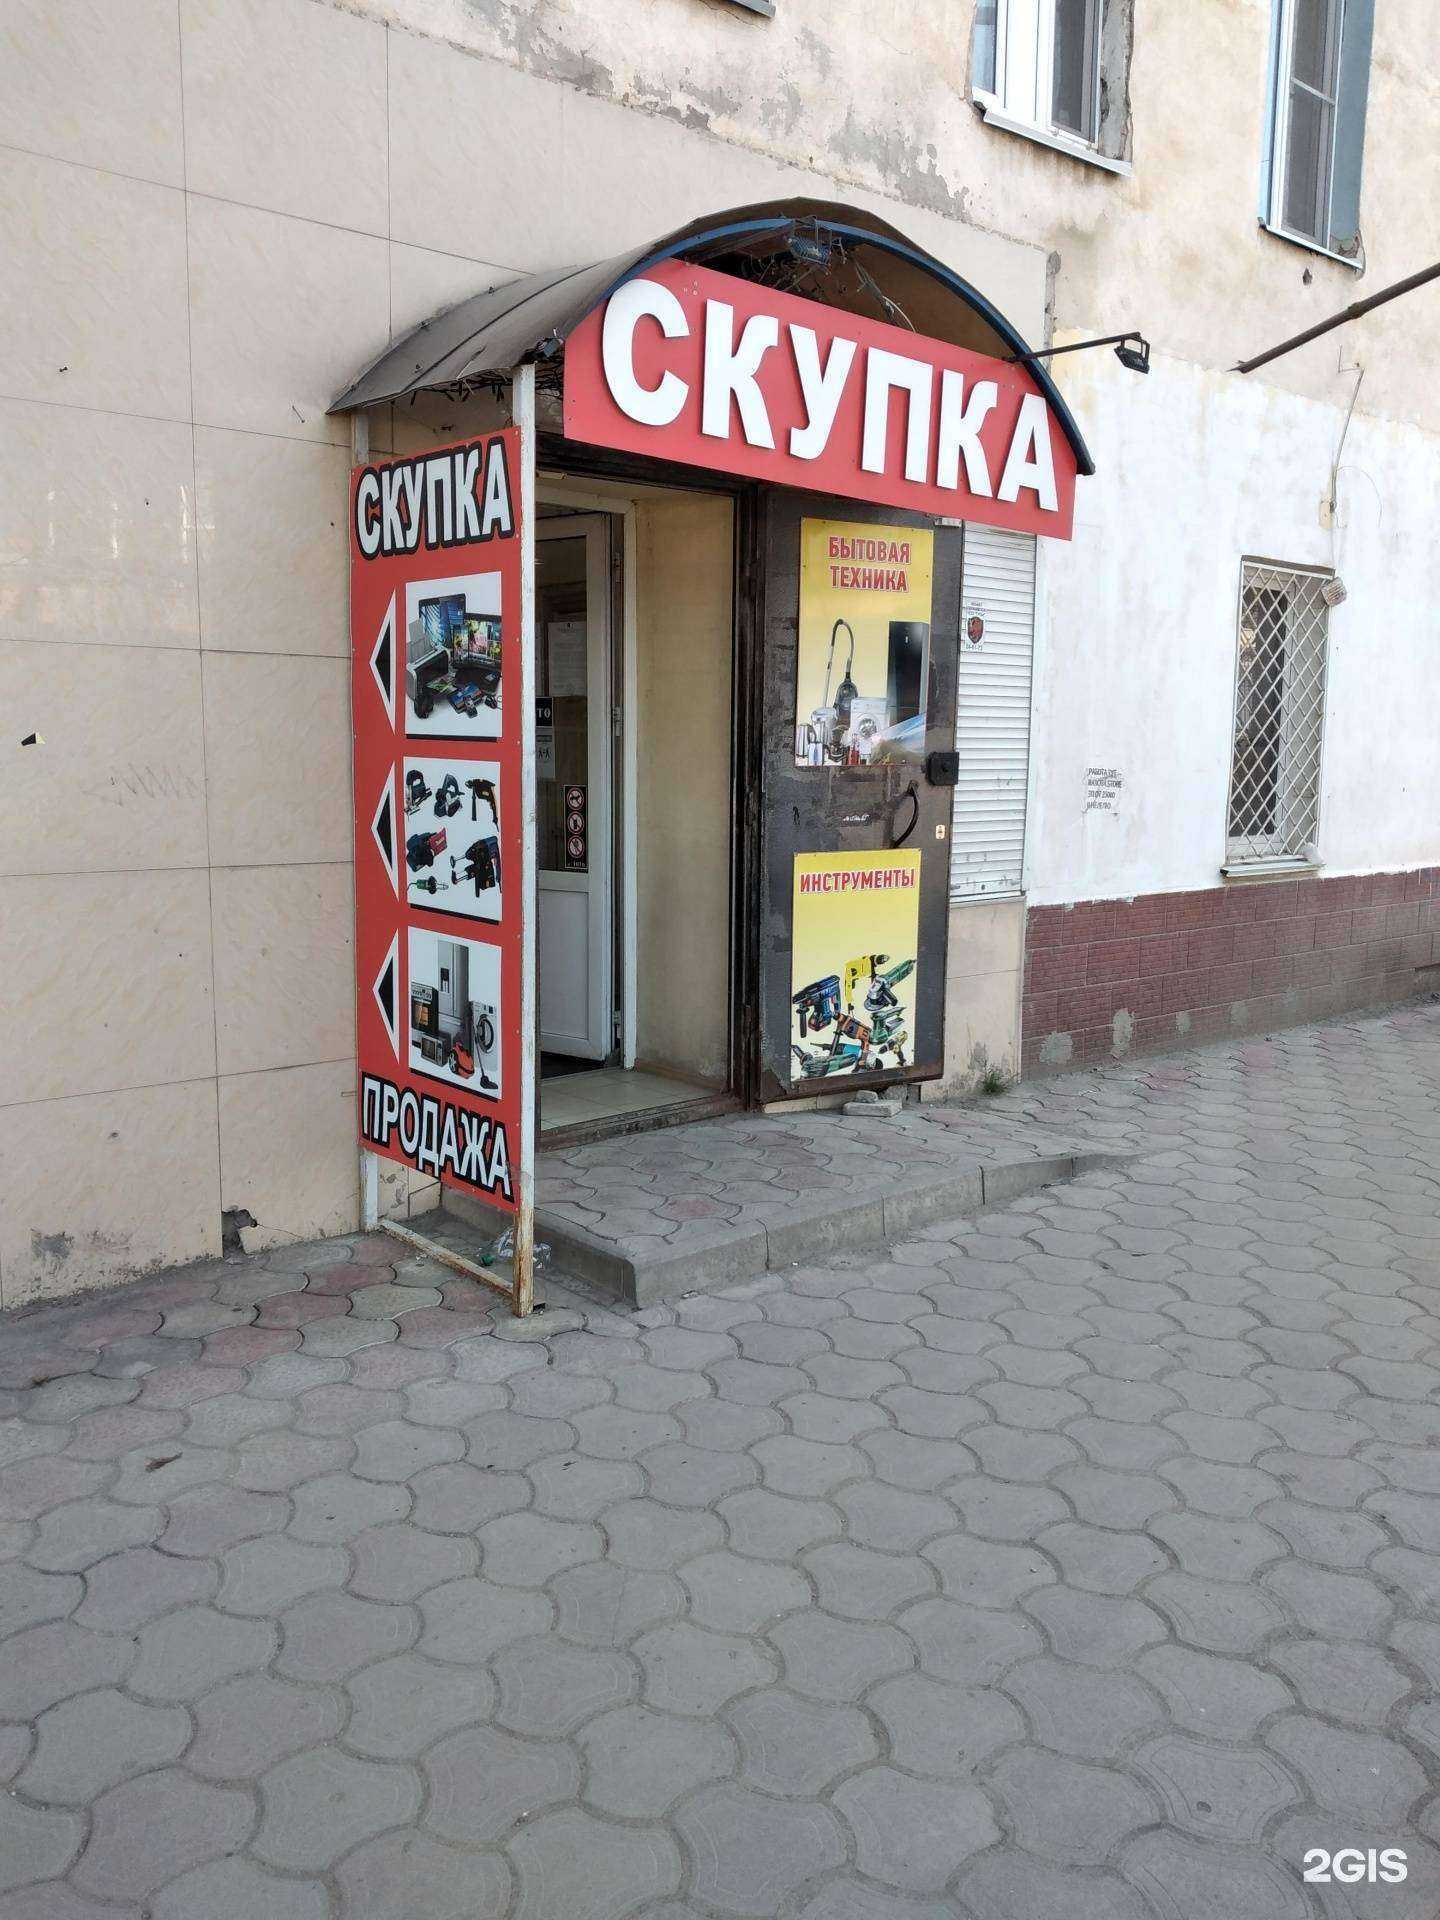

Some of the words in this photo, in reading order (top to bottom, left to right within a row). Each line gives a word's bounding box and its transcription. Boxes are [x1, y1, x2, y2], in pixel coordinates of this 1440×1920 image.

[601, 278, 1059, 513] СКУПКА
[356, 438, 513, 558] СКУПКА
[829, 536, 910, 564] БЫТОВАЯ
[830, 565, 907, 592] ТЕХНИКА
[800, 868, 915, 893] ИНСТРУМЕНТЫ
[362, 1074, 514, 1200] ПРОДАЖА
